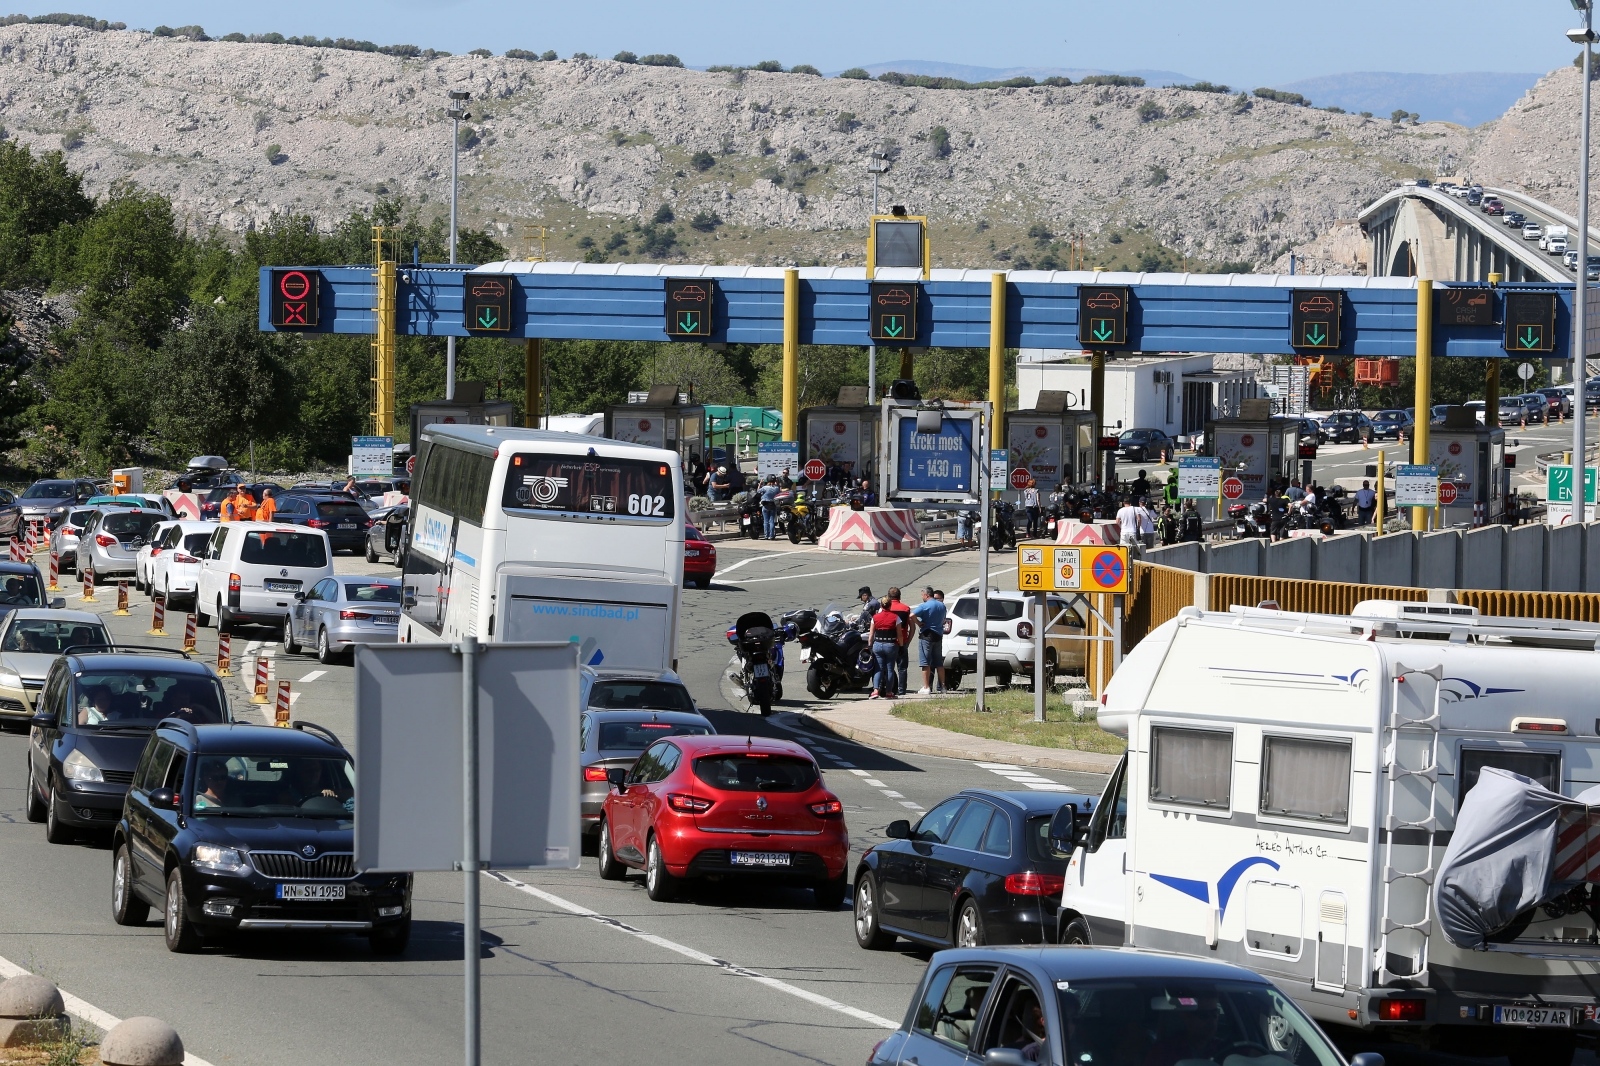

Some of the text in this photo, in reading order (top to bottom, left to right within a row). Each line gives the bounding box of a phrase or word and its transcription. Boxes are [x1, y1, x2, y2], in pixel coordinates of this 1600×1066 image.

[1455, 306, 1477, 314] CASH
[1456, 315, 1476, 323] ENC
[909, 430, 963, 451] Krčki most
[584, 462, 601, 472] ESP
[806, 466, 824, 474] STOP
[909, 458, 916, 477] L
[926, 459, 949, 477] 1430
[952, 464, 962, 478] m
[1012, 474, 1030, 483] STOP
[517, 489, 530, 498] 100
[1223, 484, 1242, 493] STOP
[628, 493, 666, 516] 602
[561, 513, 616, 521] SETRA
[1063, 568, 1071, 576] 30
[1025, 574, 1040, 585] 29
[532, 602, 640, 621] www.sindbad.pl
[737, 852, 748, 863] ZG
[283, 885, 344, 897] WN SW 1958
[1503, 1008, 1567, 1024] VO 297 AR
